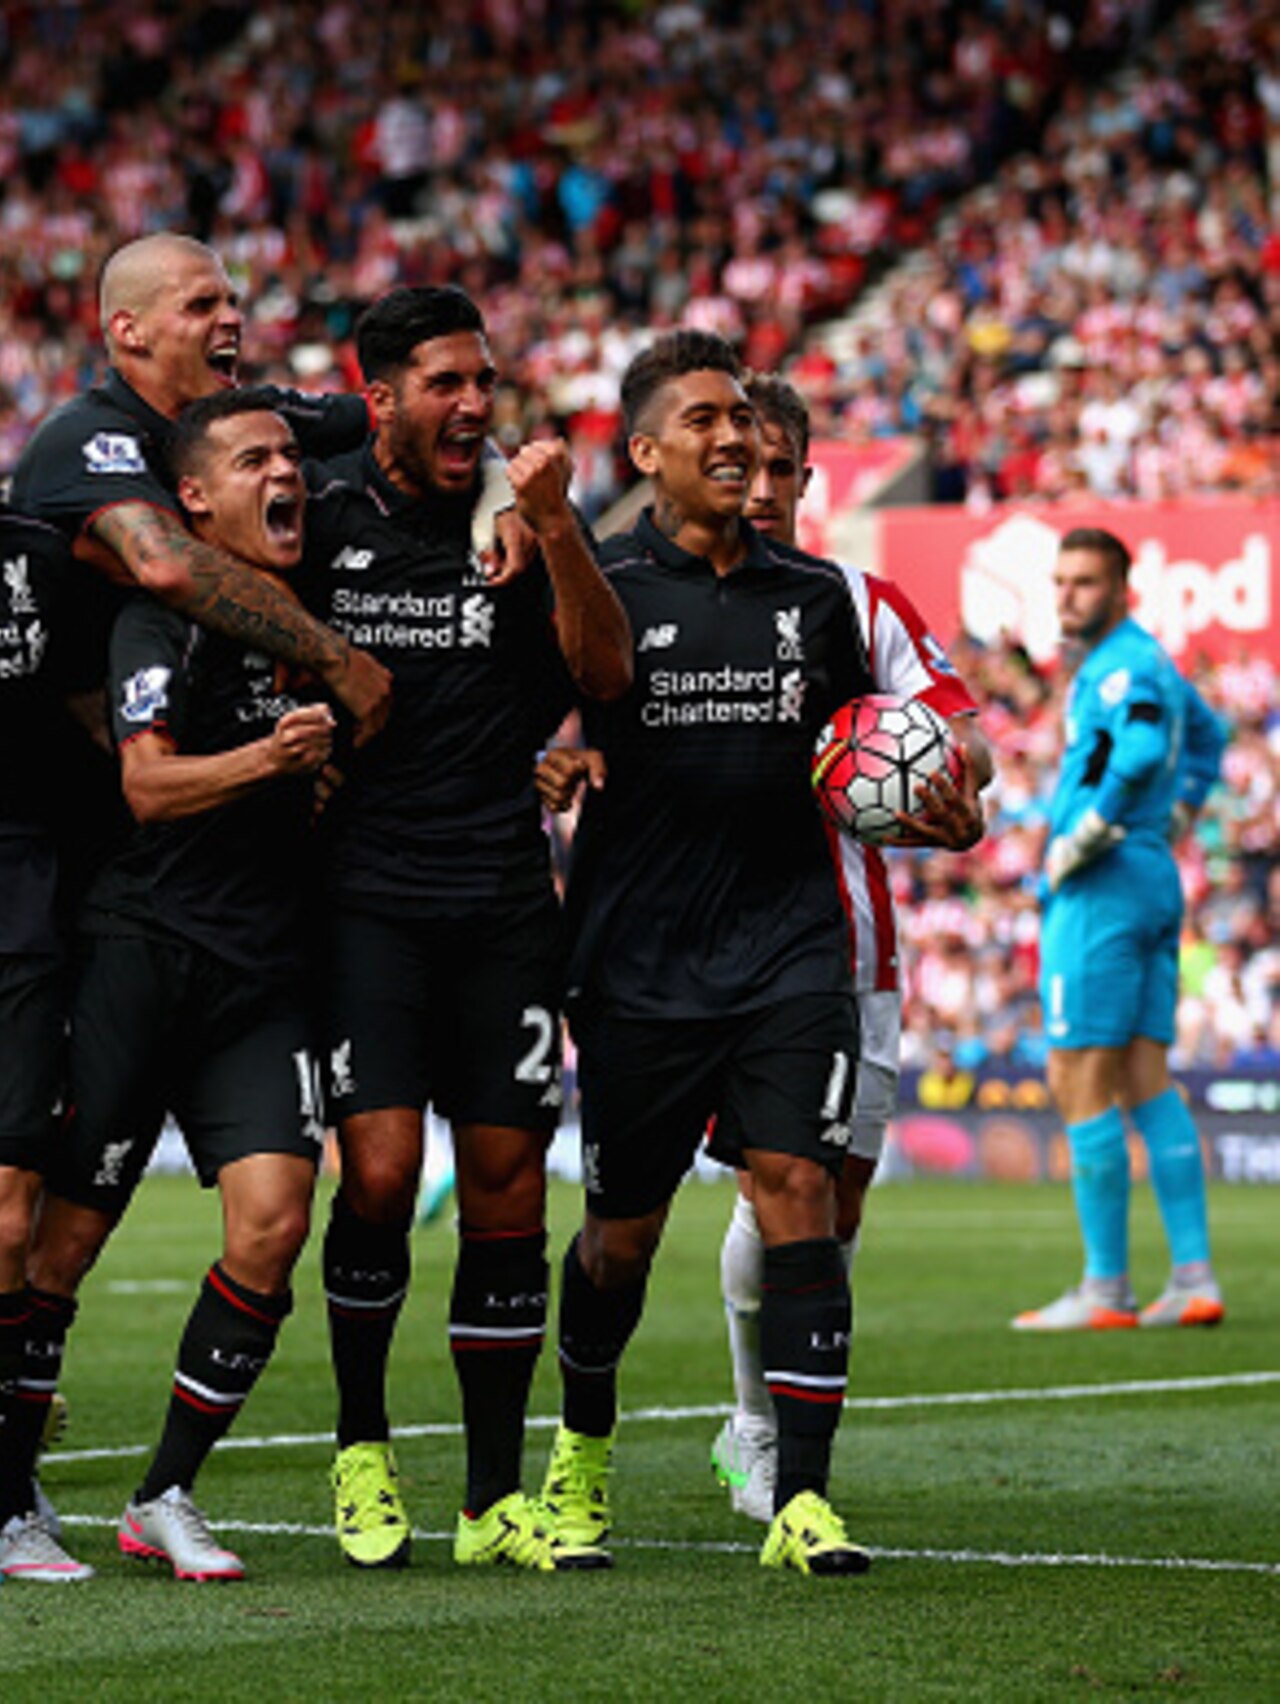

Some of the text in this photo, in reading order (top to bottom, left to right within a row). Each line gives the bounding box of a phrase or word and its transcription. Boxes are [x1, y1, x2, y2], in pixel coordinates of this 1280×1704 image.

[332, 588, 456, 618] Standard
[1127, 535, 1270, 656] dpd
[649, 664, 774, 696] Standard
[640, 697, 774, 727] Chartered
